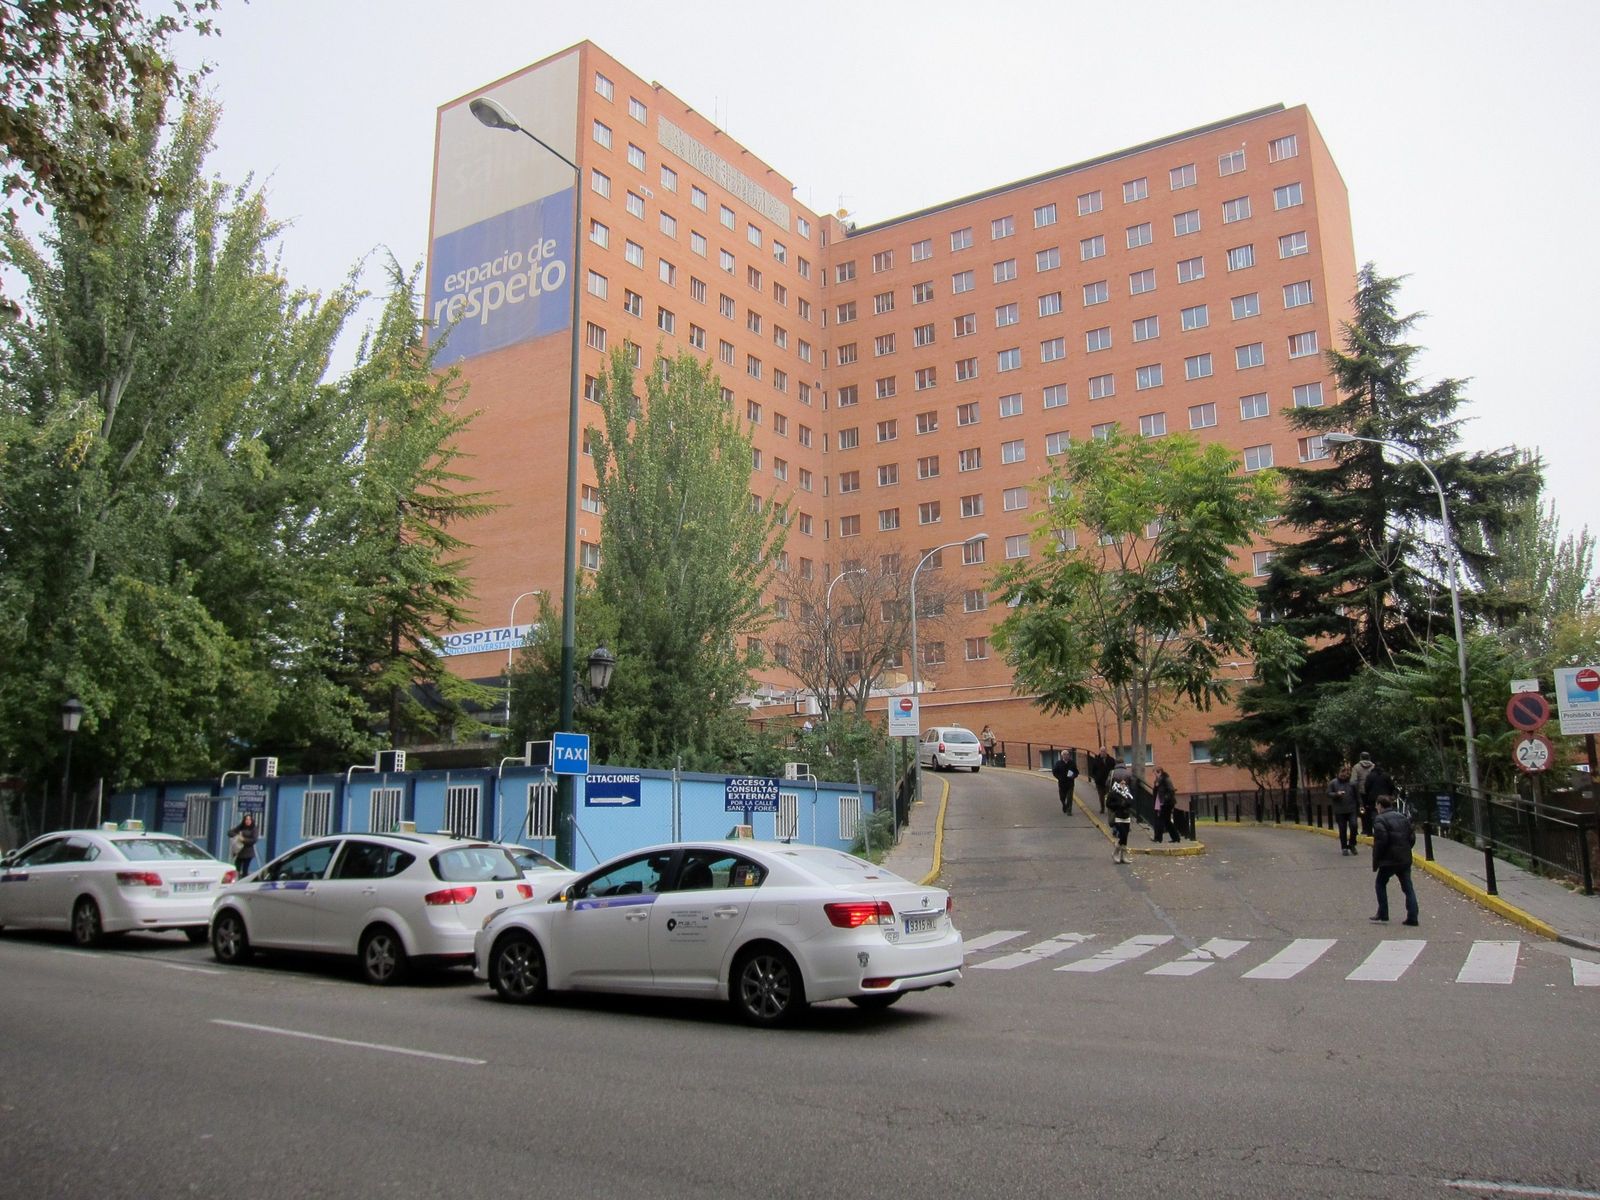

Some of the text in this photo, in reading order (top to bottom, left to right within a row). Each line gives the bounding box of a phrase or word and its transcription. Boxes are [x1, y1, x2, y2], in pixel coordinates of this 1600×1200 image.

[444, 238, 557, 293] espacio de
[433, 260, 566, 329] respeto
[556, 747, 587, 761] TAXI
[586, 775, 640, 783] CITACIONES
[910, 919, 926, 932] 9315
